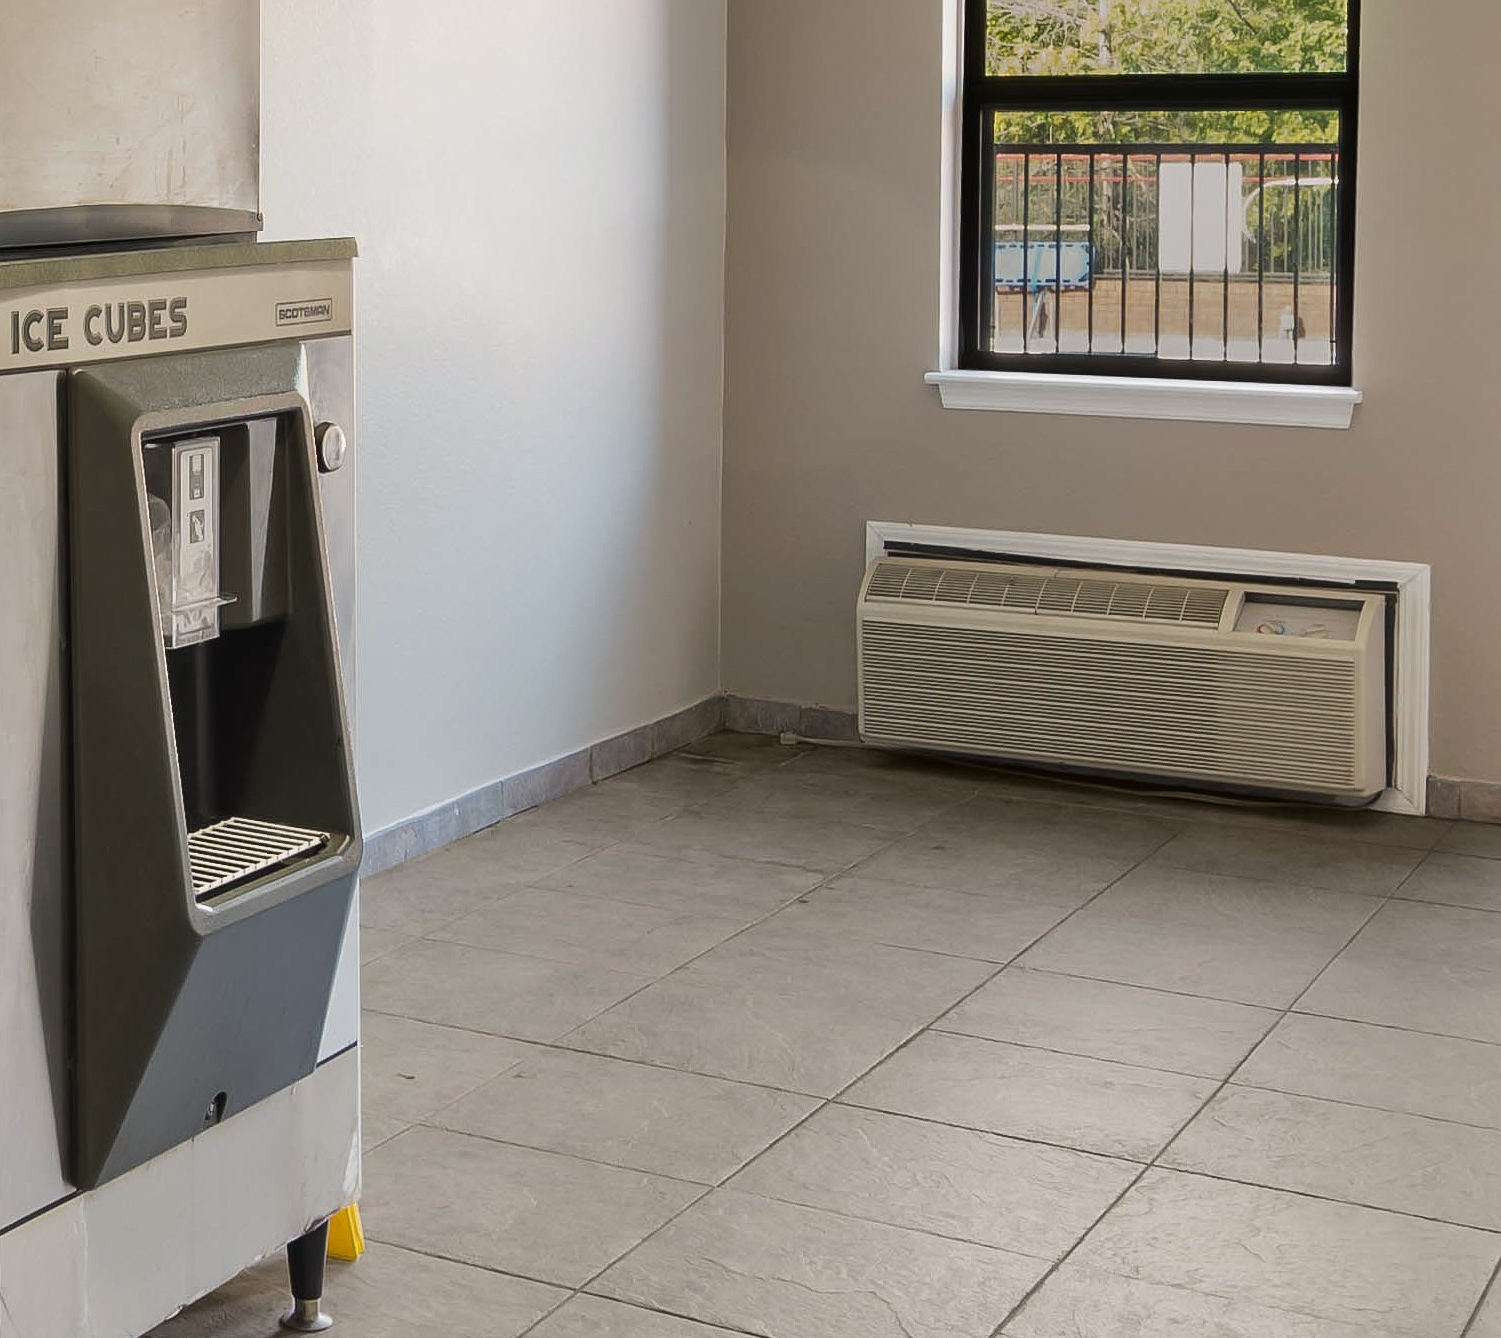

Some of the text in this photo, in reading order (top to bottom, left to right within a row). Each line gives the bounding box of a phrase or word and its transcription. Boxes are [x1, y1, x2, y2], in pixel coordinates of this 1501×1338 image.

[11, 297, 187, 355] ICE CUBES
[278, 304, 330, 321] SCOTSMAN
